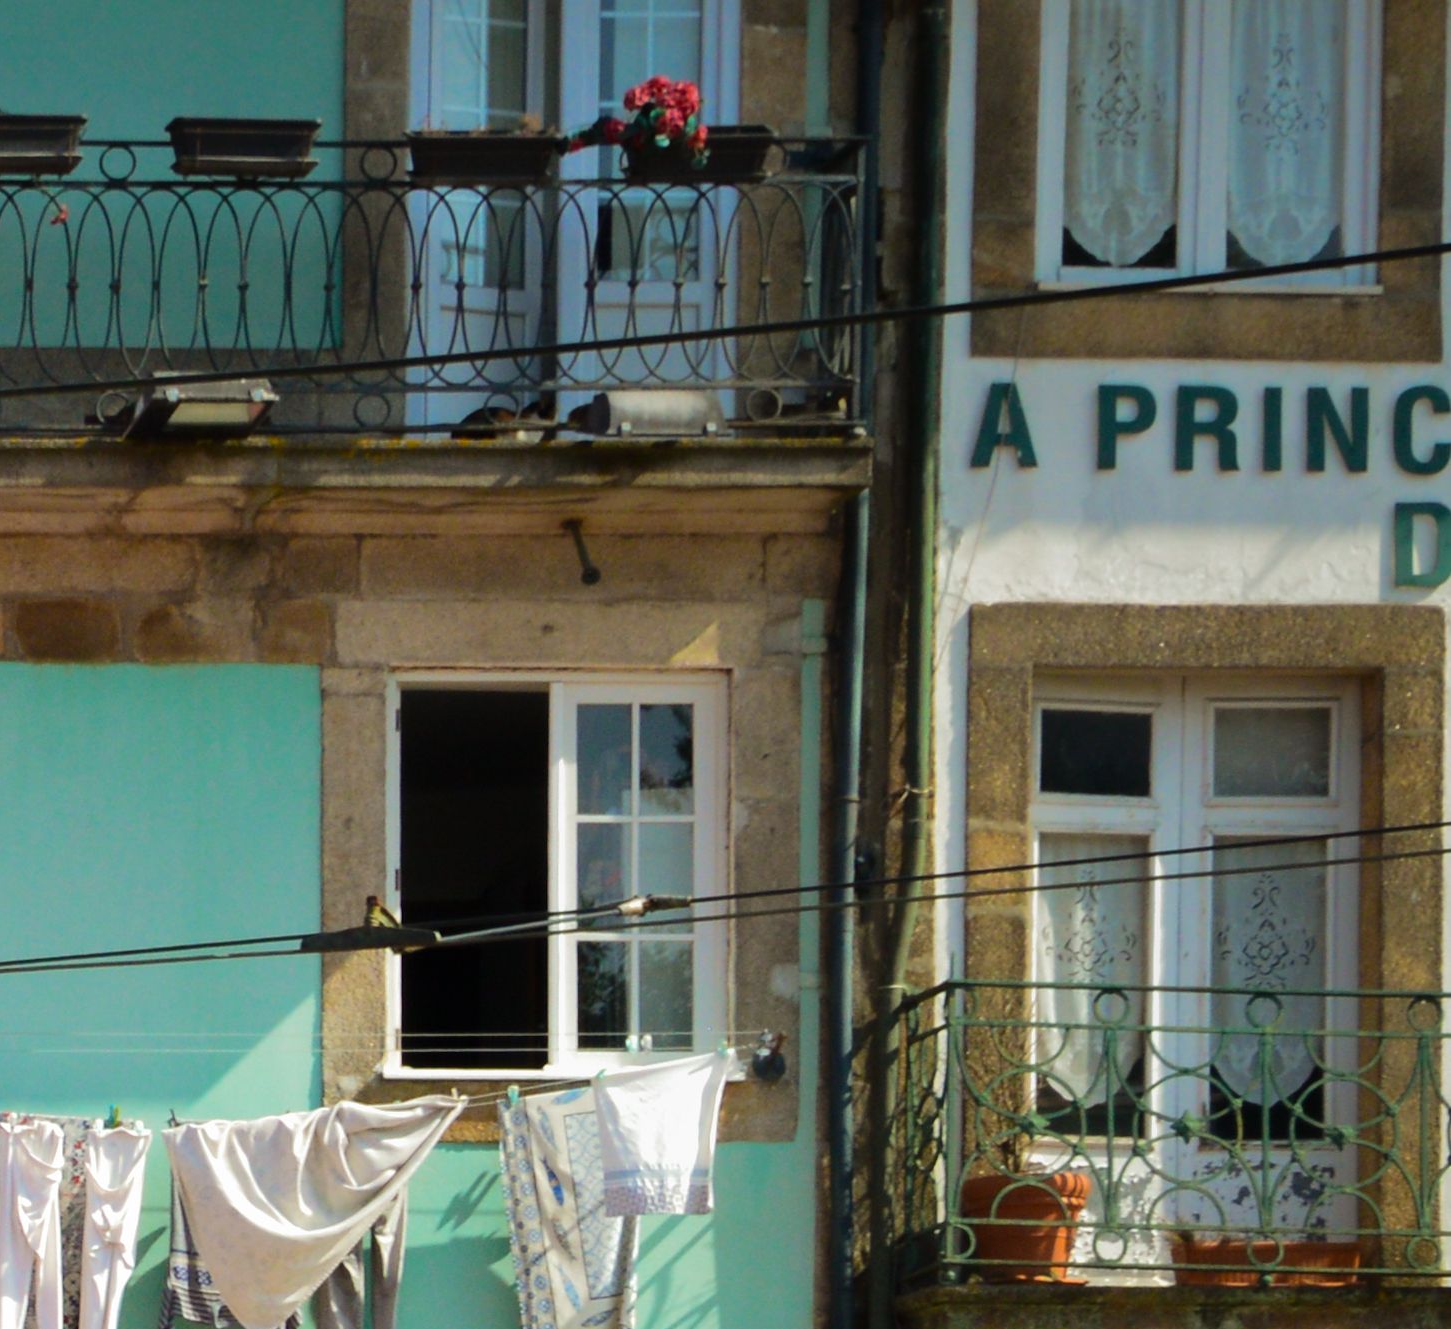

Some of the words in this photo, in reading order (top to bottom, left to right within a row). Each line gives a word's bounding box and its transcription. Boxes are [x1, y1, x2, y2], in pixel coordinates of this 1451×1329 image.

[970, 382, 1038, 468] A
[1096, 384, 1451, 476] PRINC
[1393, 501, 1451, 590] D
